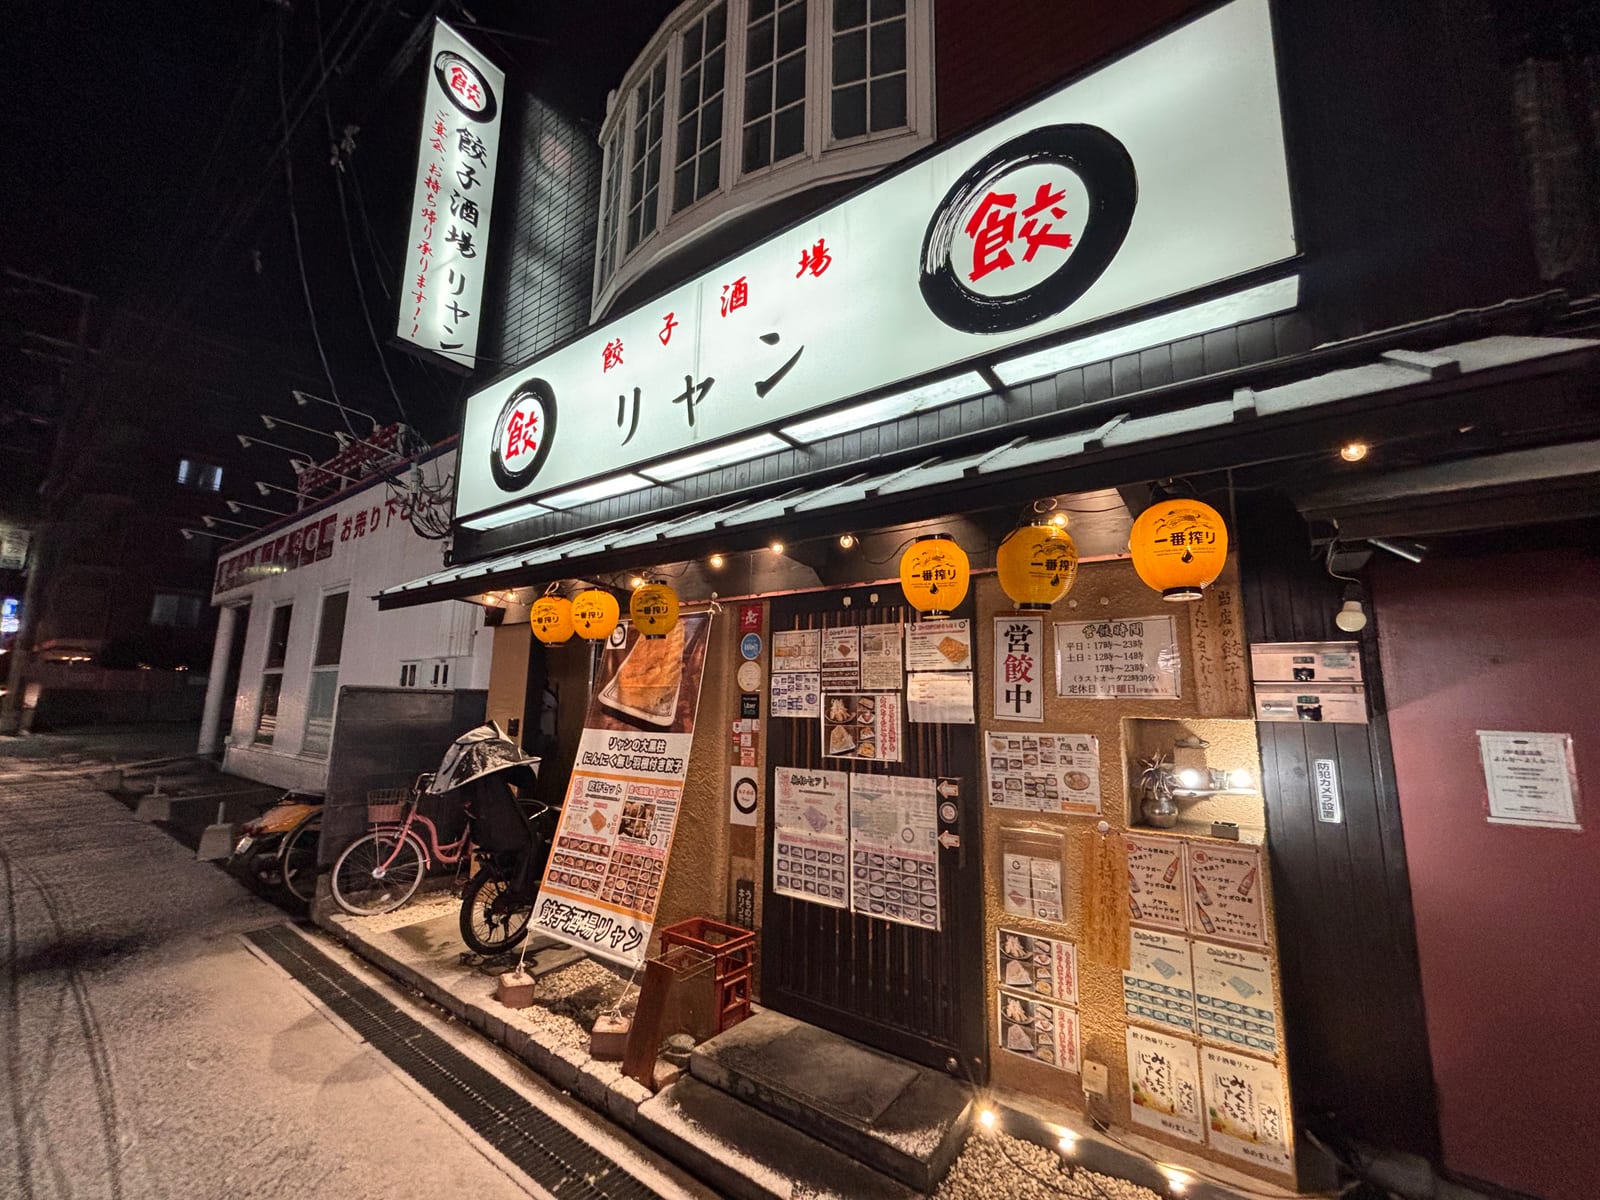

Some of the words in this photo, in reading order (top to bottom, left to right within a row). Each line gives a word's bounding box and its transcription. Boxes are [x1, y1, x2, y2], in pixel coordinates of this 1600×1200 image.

[450, 65, 482, 109] 餃
[965, 182, 1074, 283] 餃
[602, 238, 833, 374] 餃子酒場
[504, 408, 538, 461] 餃
[1154, 530, 1216, 547] 一番搾り
[911, 568, 957, 582] 一番搾り
[1031, 558, 1076, 573] 一番搾り
[1003, 623, 1034, 714] 営餃中
